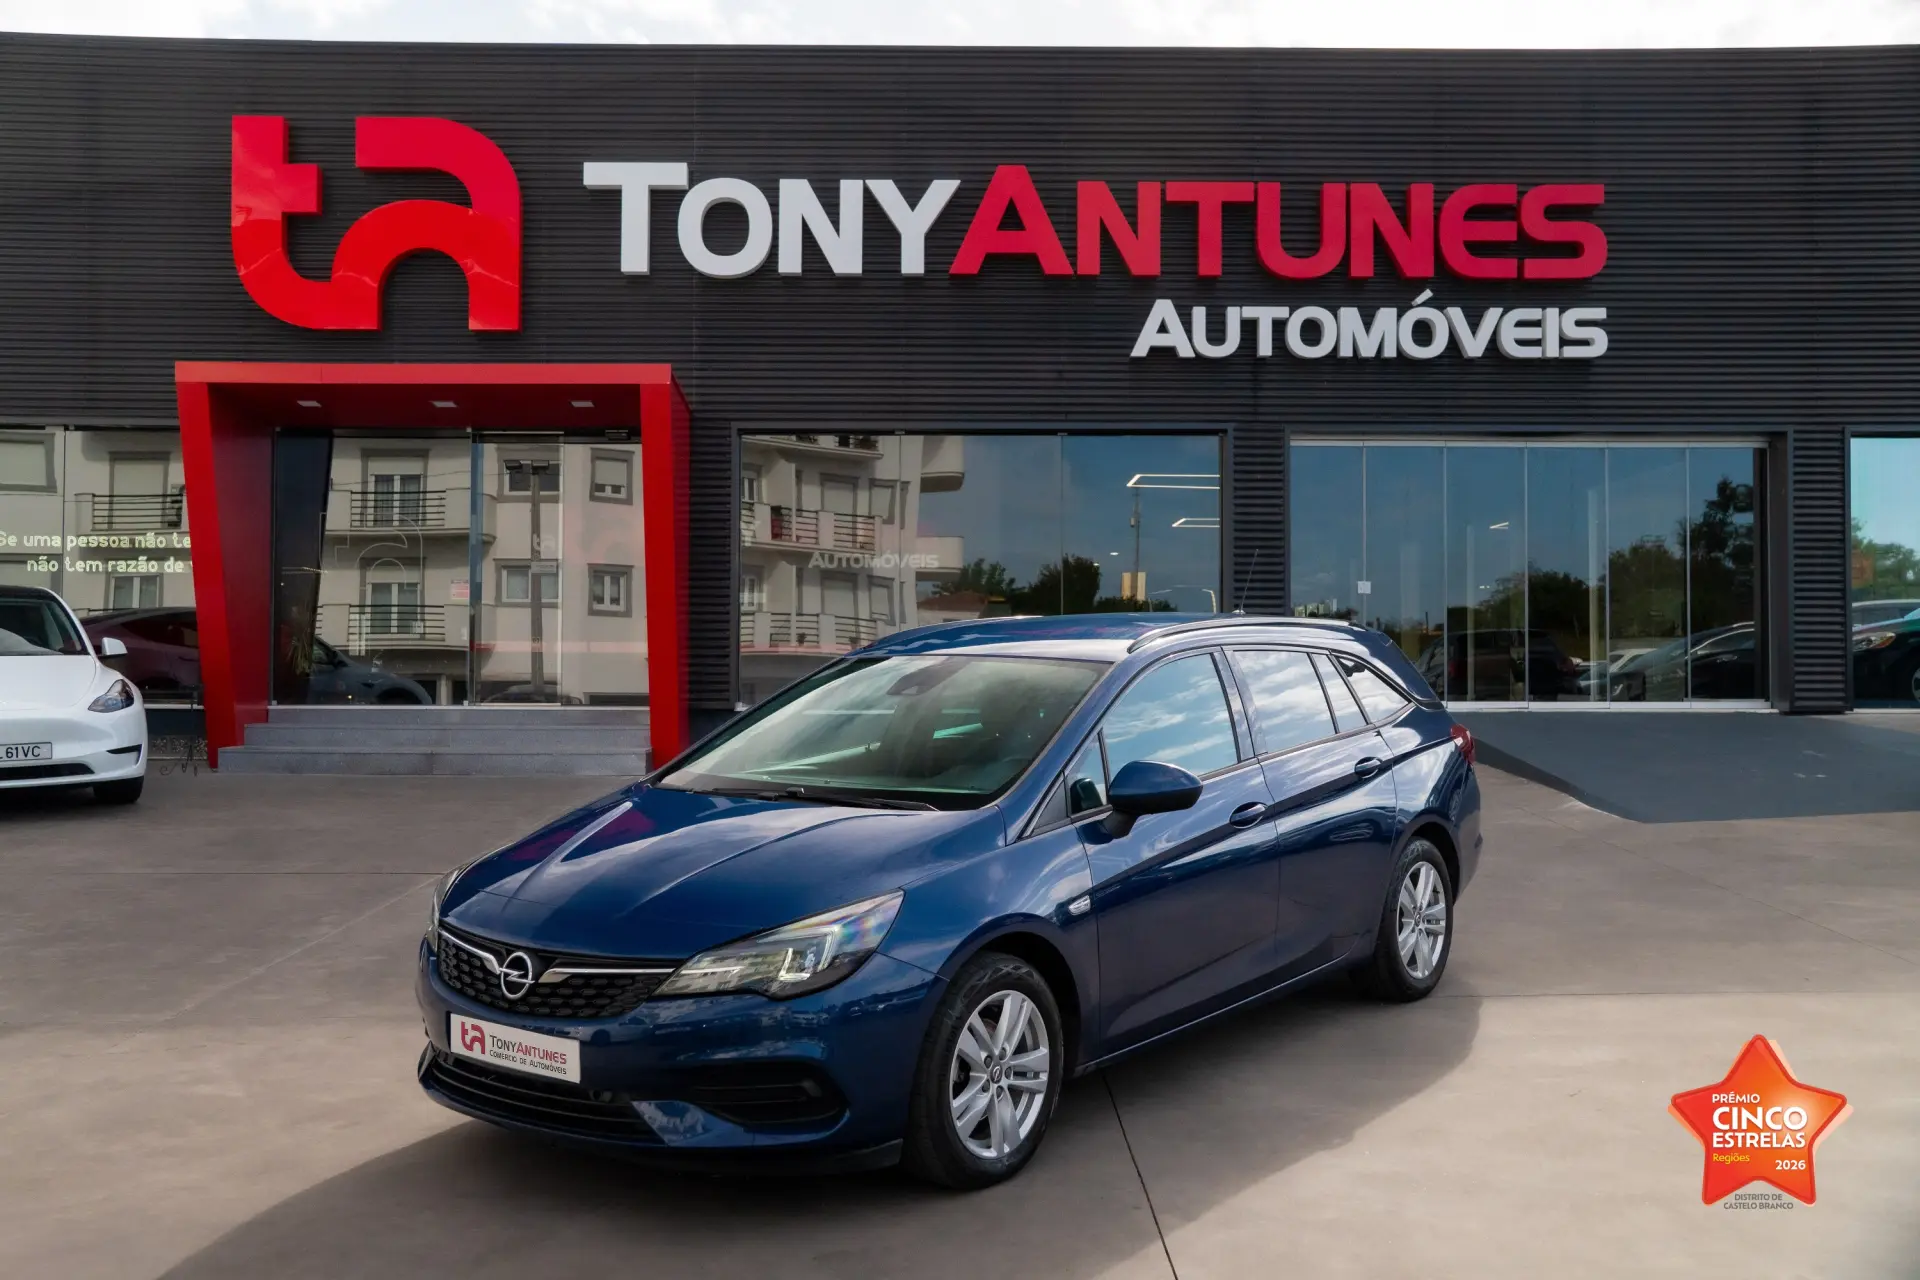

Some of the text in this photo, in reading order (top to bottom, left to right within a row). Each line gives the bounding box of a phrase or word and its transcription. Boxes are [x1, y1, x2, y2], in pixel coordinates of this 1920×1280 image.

[1129, 288, 1609, 360] AUTOMÓVEIS
[0, 531, 17, 547] Se
[23, 535, 62, 547] uma
[67, 535, 132, 551] pessoa
[135, 532, 167, 548] não
[27, 556, 59, 572] não
[65, 557, 103, 572] tem
[108, 556, 159, 572] razão
[164, 557, 185, 572] de
[808, 550, 940, 568] AUTOMÓVEIS
[0, 745, 41, 759] 61VC
[519, 1057, 527, 1066] DE
[529, 1059, 567, 1075] AUTOMÓVEIS
